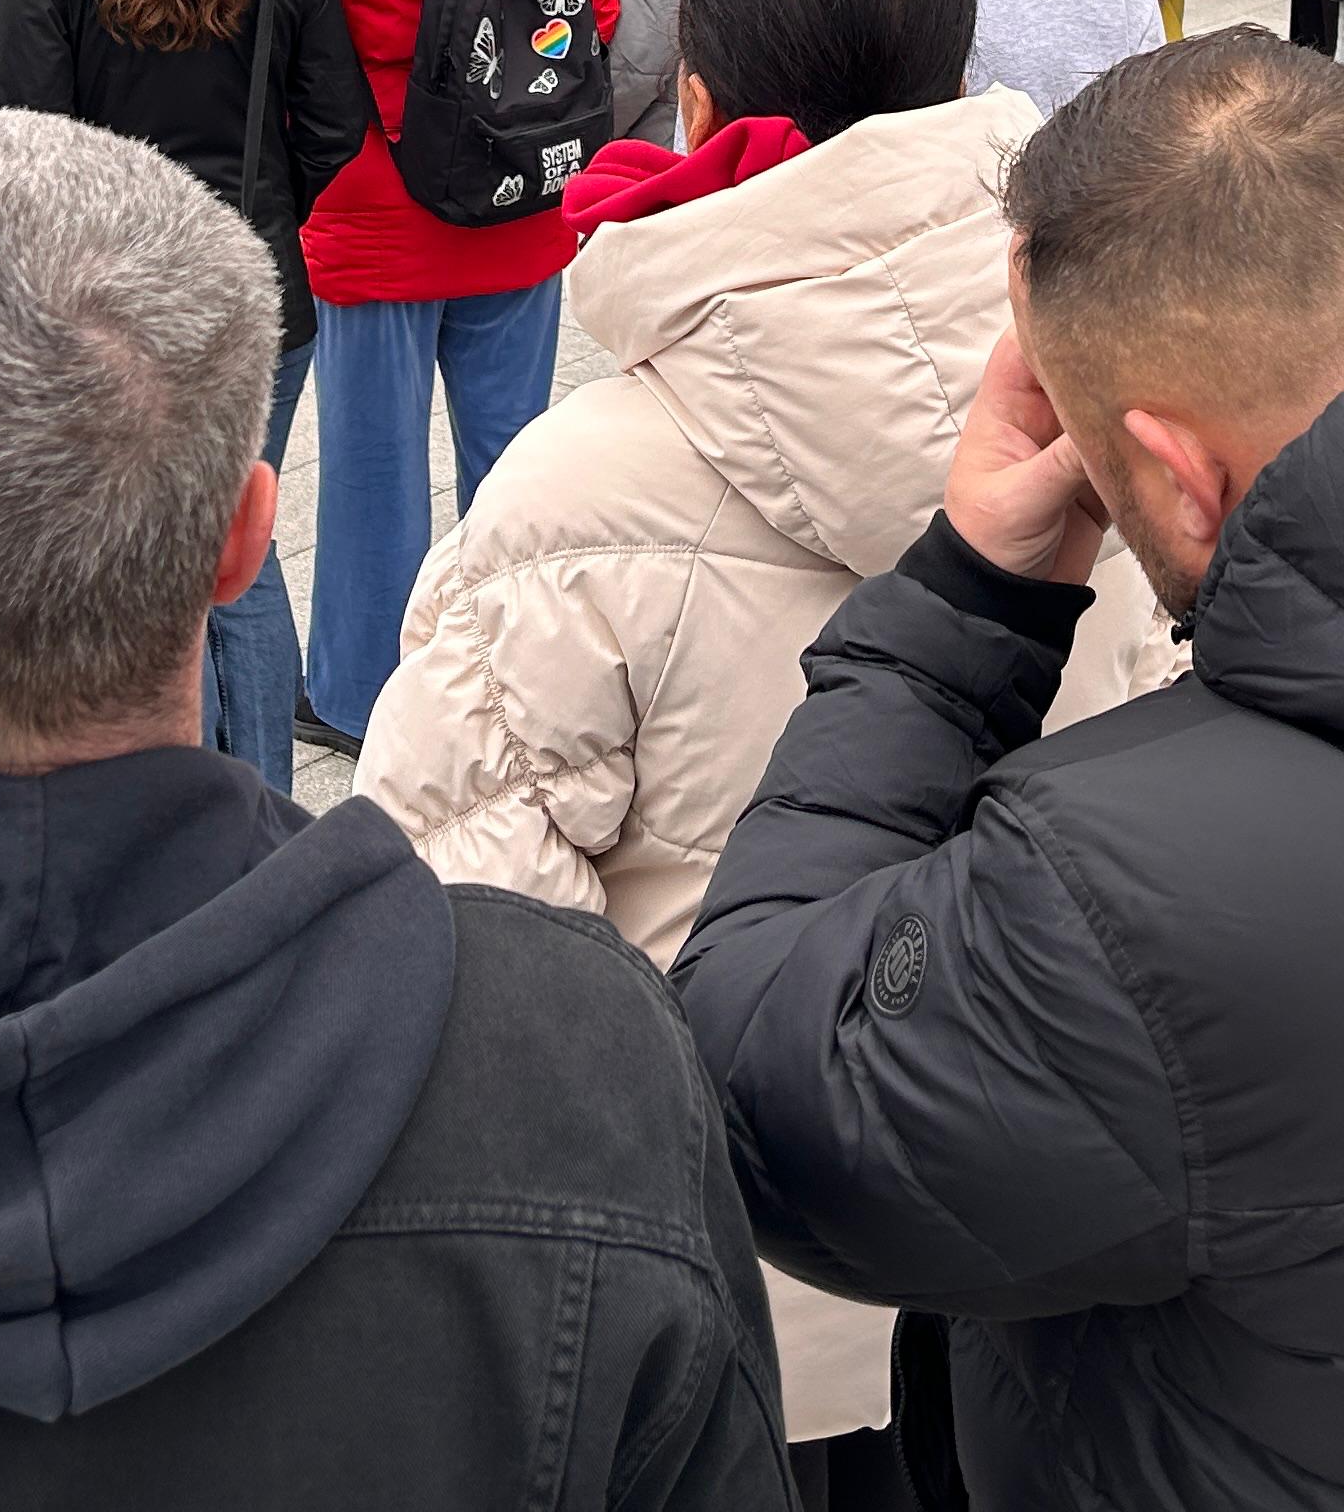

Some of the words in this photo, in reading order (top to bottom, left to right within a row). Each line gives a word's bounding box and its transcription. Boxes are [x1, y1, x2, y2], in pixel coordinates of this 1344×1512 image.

[542, 138, 582, 168] SYSTEM
[545, 164, 567, 179] OF
[568, 160, 581, 174] A
